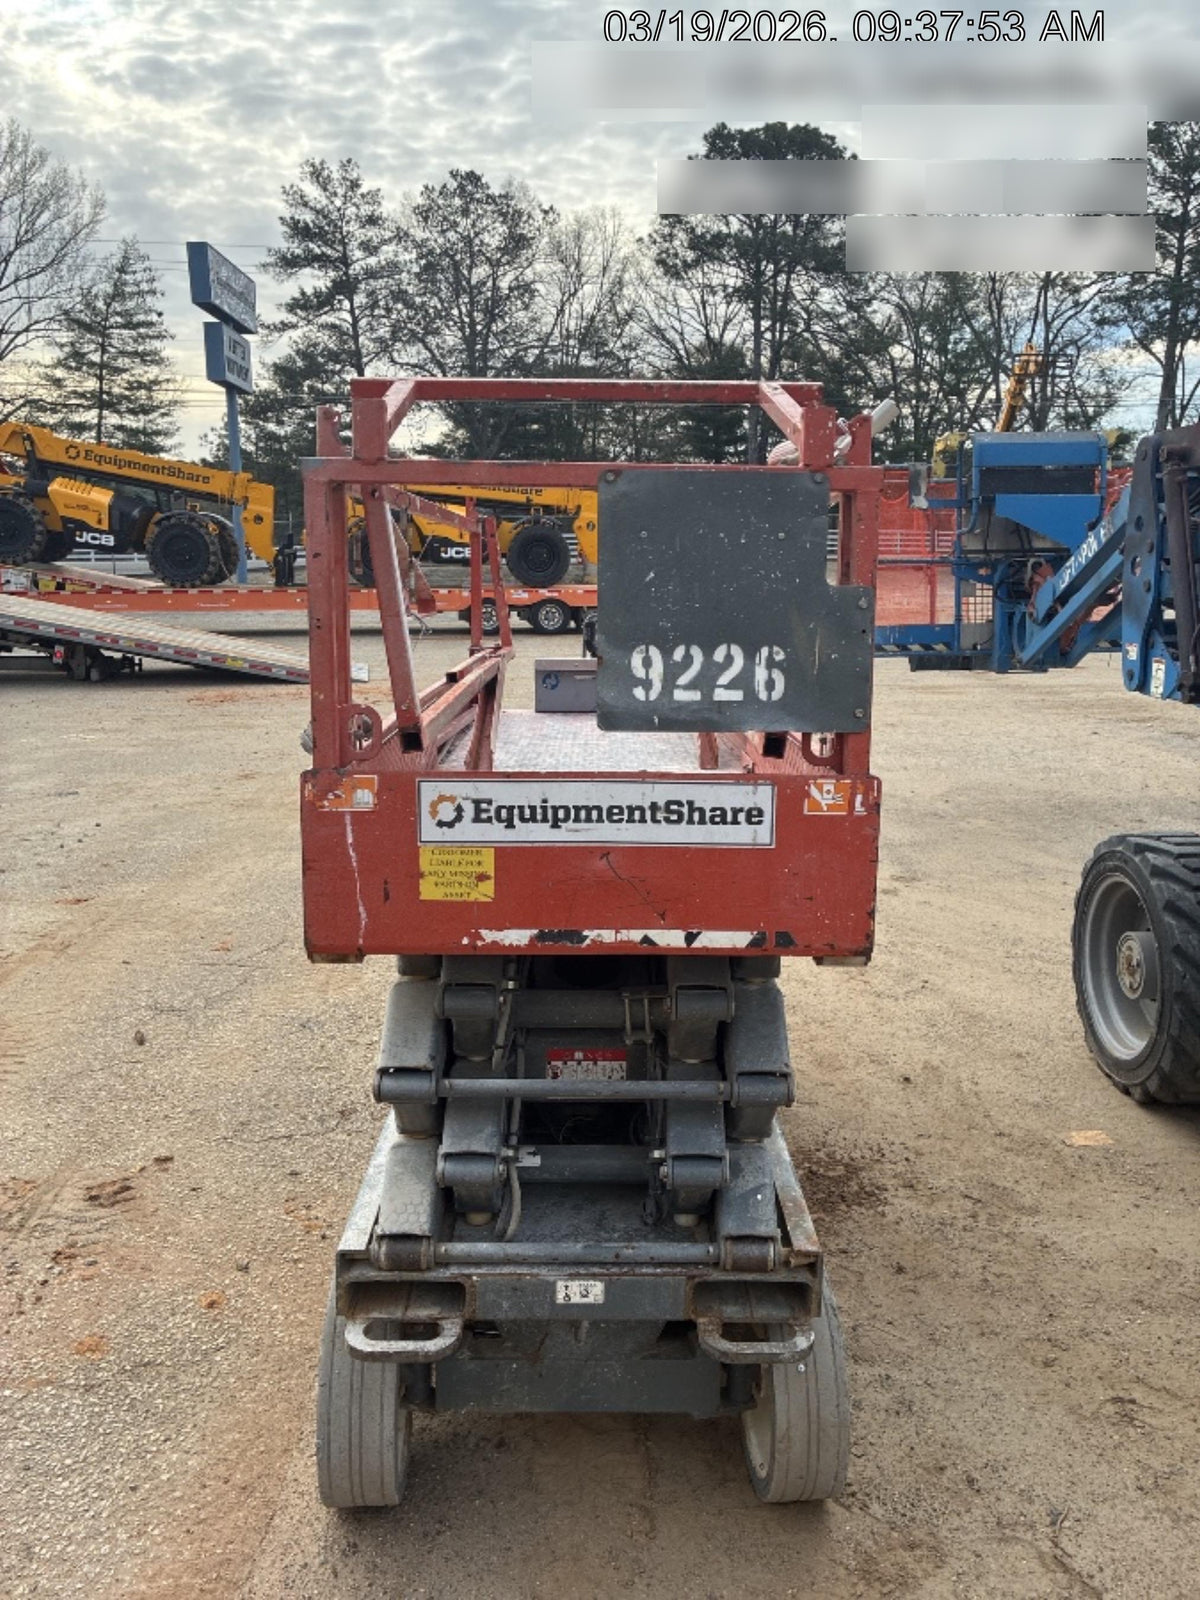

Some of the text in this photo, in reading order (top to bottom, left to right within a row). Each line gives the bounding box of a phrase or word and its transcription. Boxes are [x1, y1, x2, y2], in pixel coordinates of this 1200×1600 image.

[84, 449, 211, 484] EquipmentShare
[75, 531, 115, 546] JCB
[630, 643, 786, 702] 9226
[471, 798, 765, 829] EquipmentShare
